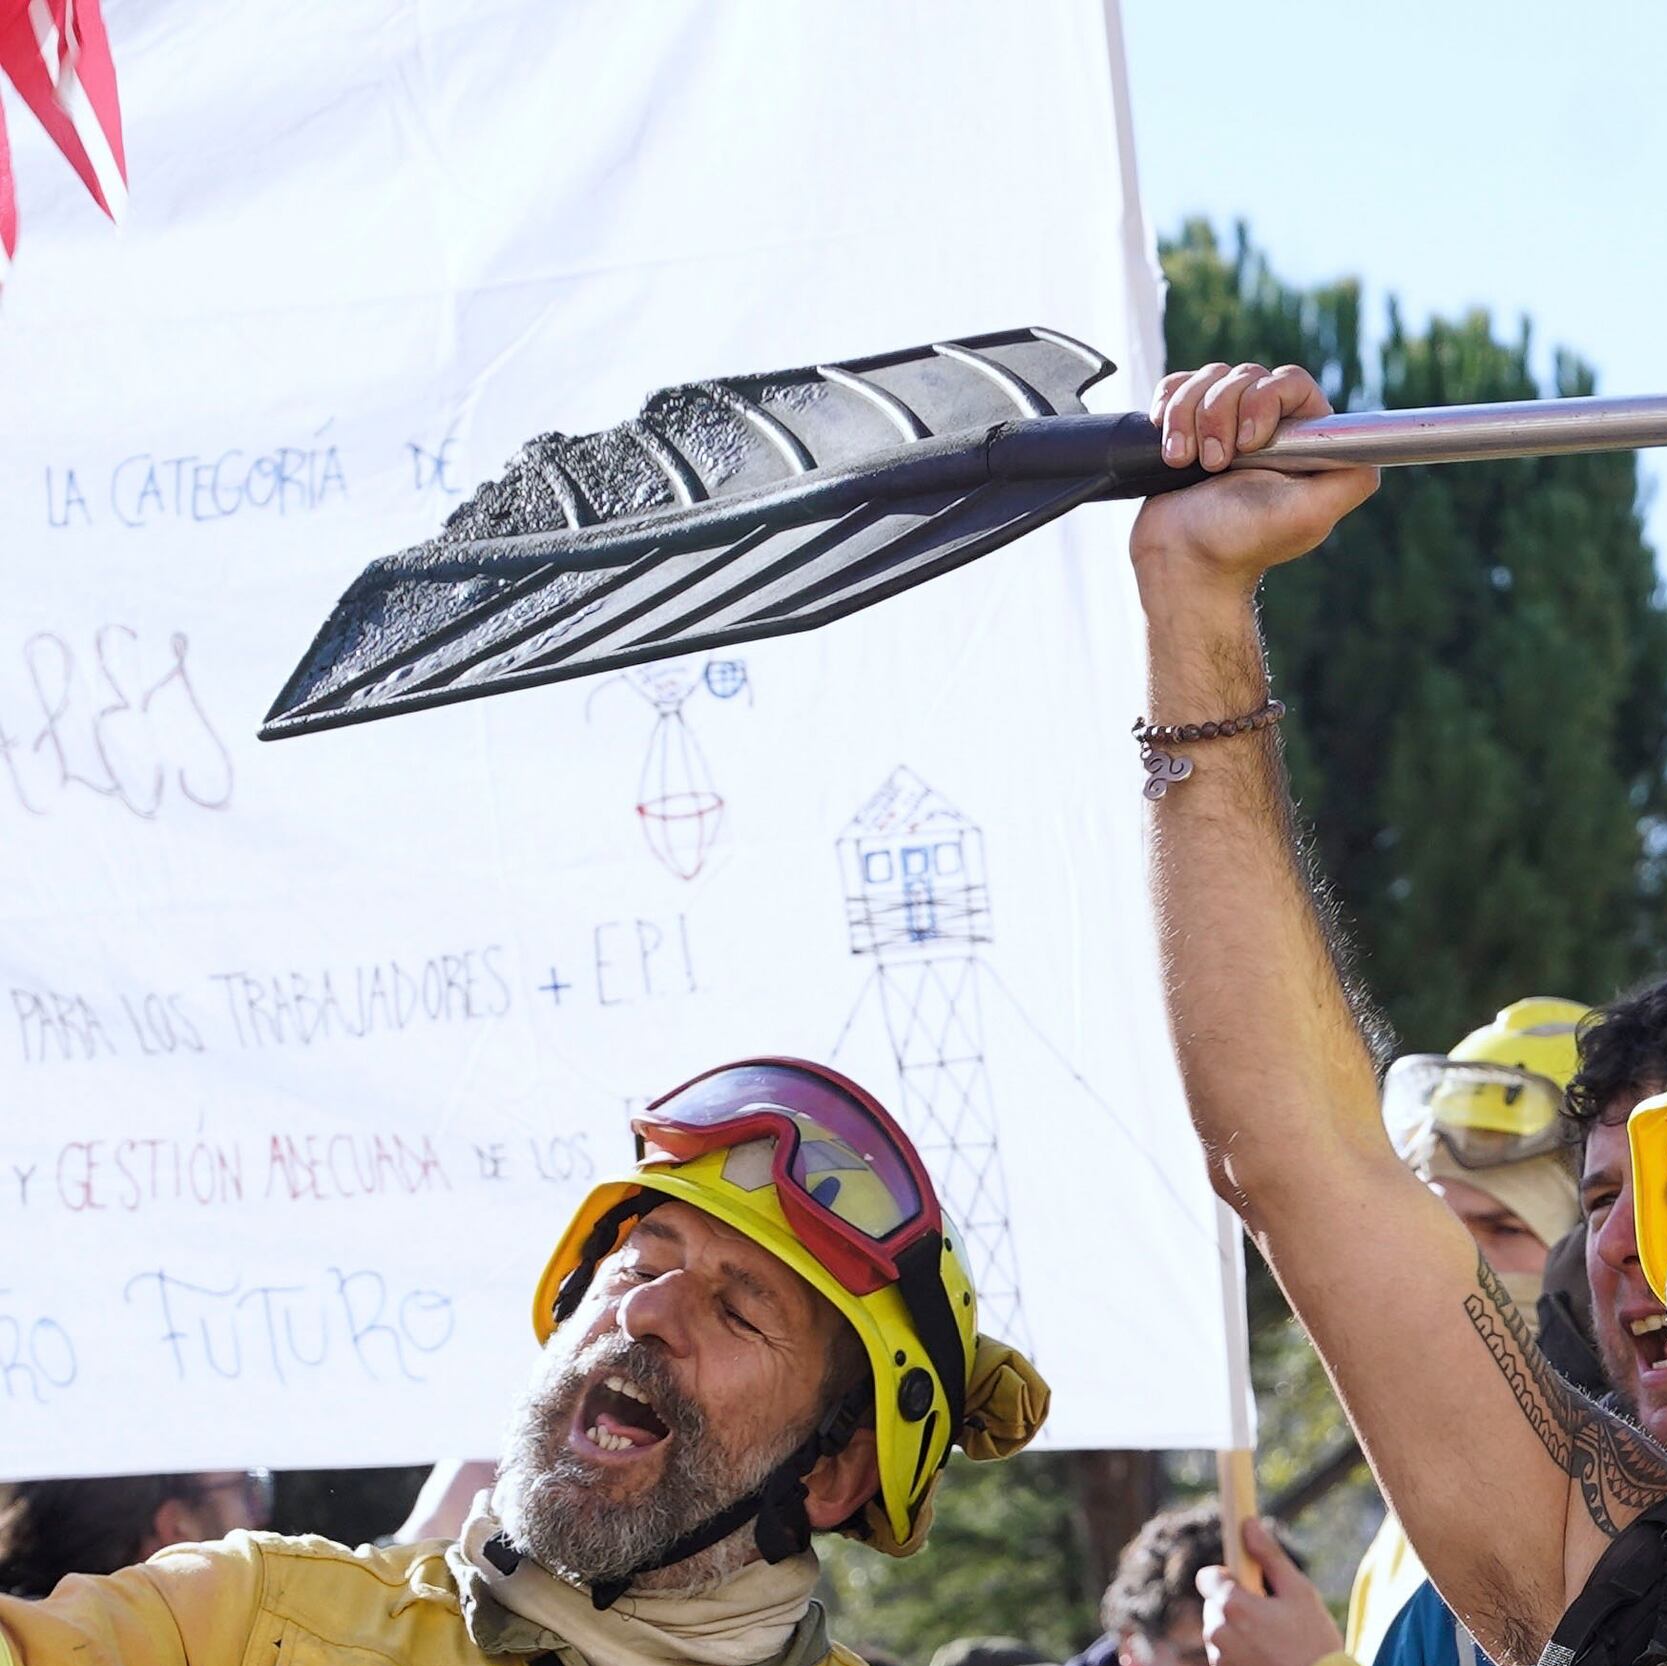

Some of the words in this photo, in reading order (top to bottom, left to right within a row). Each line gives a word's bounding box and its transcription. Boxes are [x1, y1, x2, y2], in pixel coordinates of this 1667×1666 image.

[46, 464, 92, 527] LA
[112, 417, 350, 527] CATEGORÍA
[405, 436, 463, 493] DE
[10, 987, 118, 1063] PARA
[119, 992, 207, 1056] LOS
[208, 944, 511, 1049] TRABAJADORES
[539, 966, 573, 1005] +
[12, 1164, 37, 1205] Y
[57, 1107, 243, 1212] GESTIÓN
[265, 1132, 453, 1201] ADECUADA
[473, 1142, 506, 1182] DE
[530, 1130, 597, 1183] LOS
[123, 1267, 456, 1386] FUTURO
